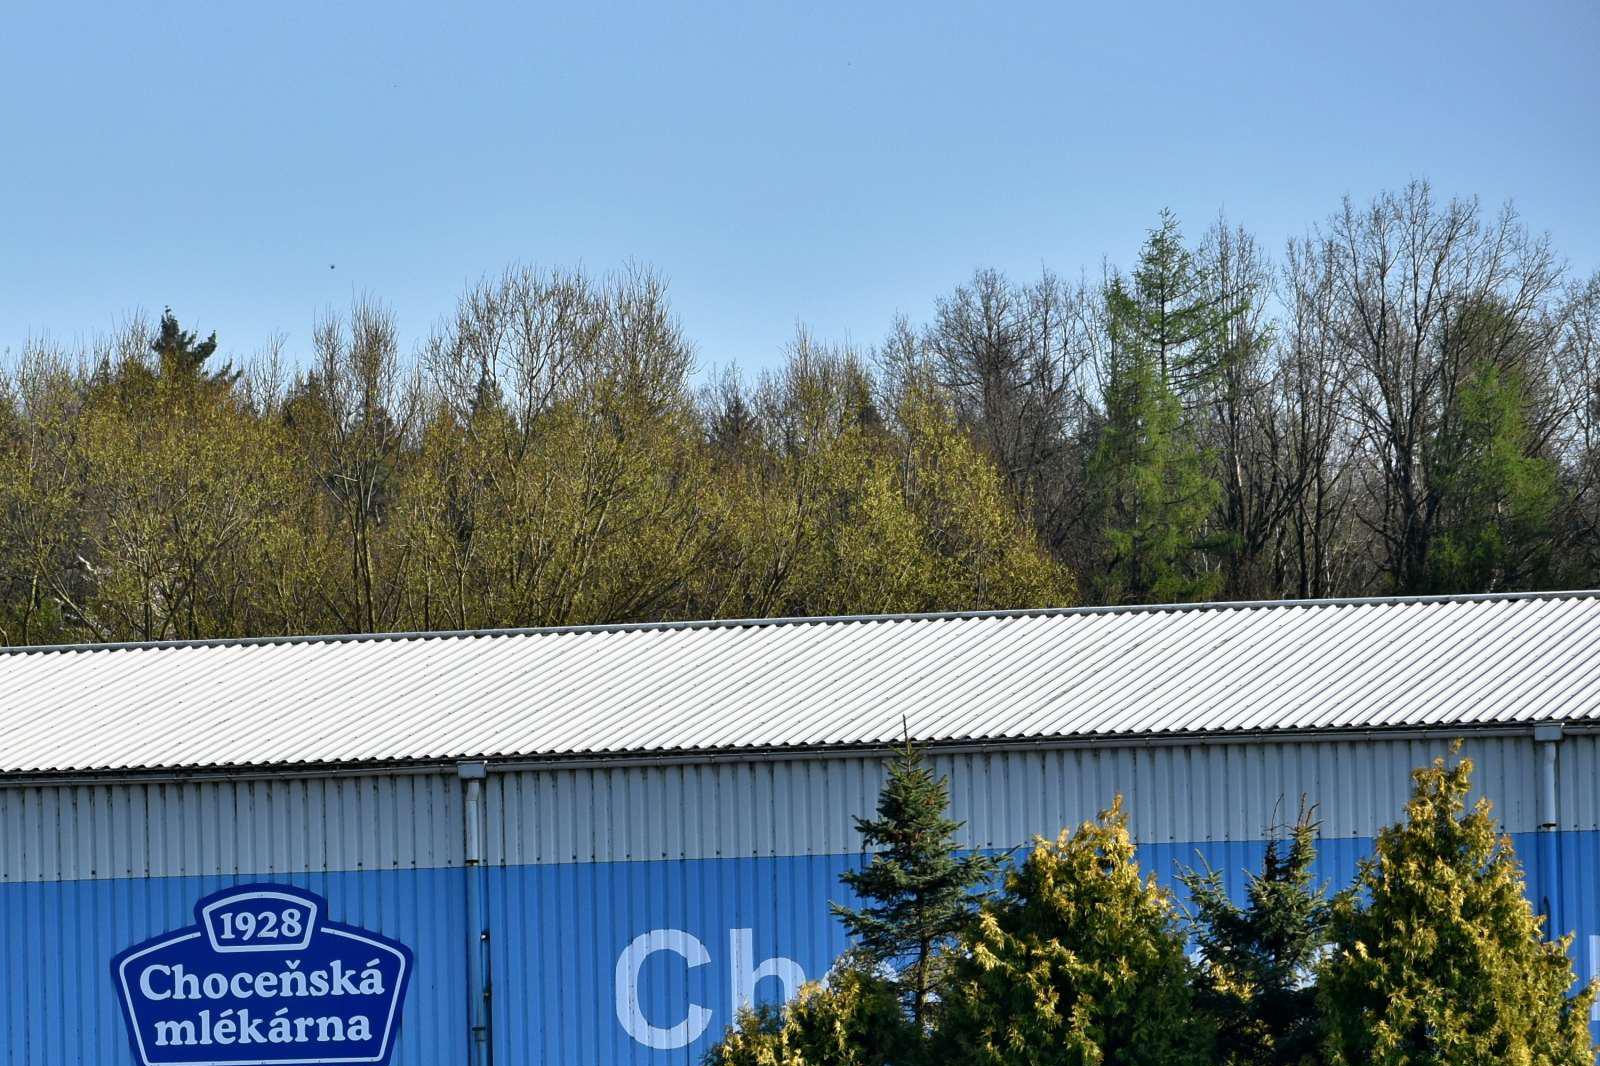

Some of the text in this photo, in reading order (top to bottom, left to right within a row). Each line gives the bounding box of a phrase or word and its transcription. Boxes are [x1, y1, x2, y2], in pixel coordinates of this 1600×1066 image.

[220, 909, 302, 941] 1928
[139, 958, 385, 1001] Choceňská
[154, 1007, 372, 1046] mlékárna
